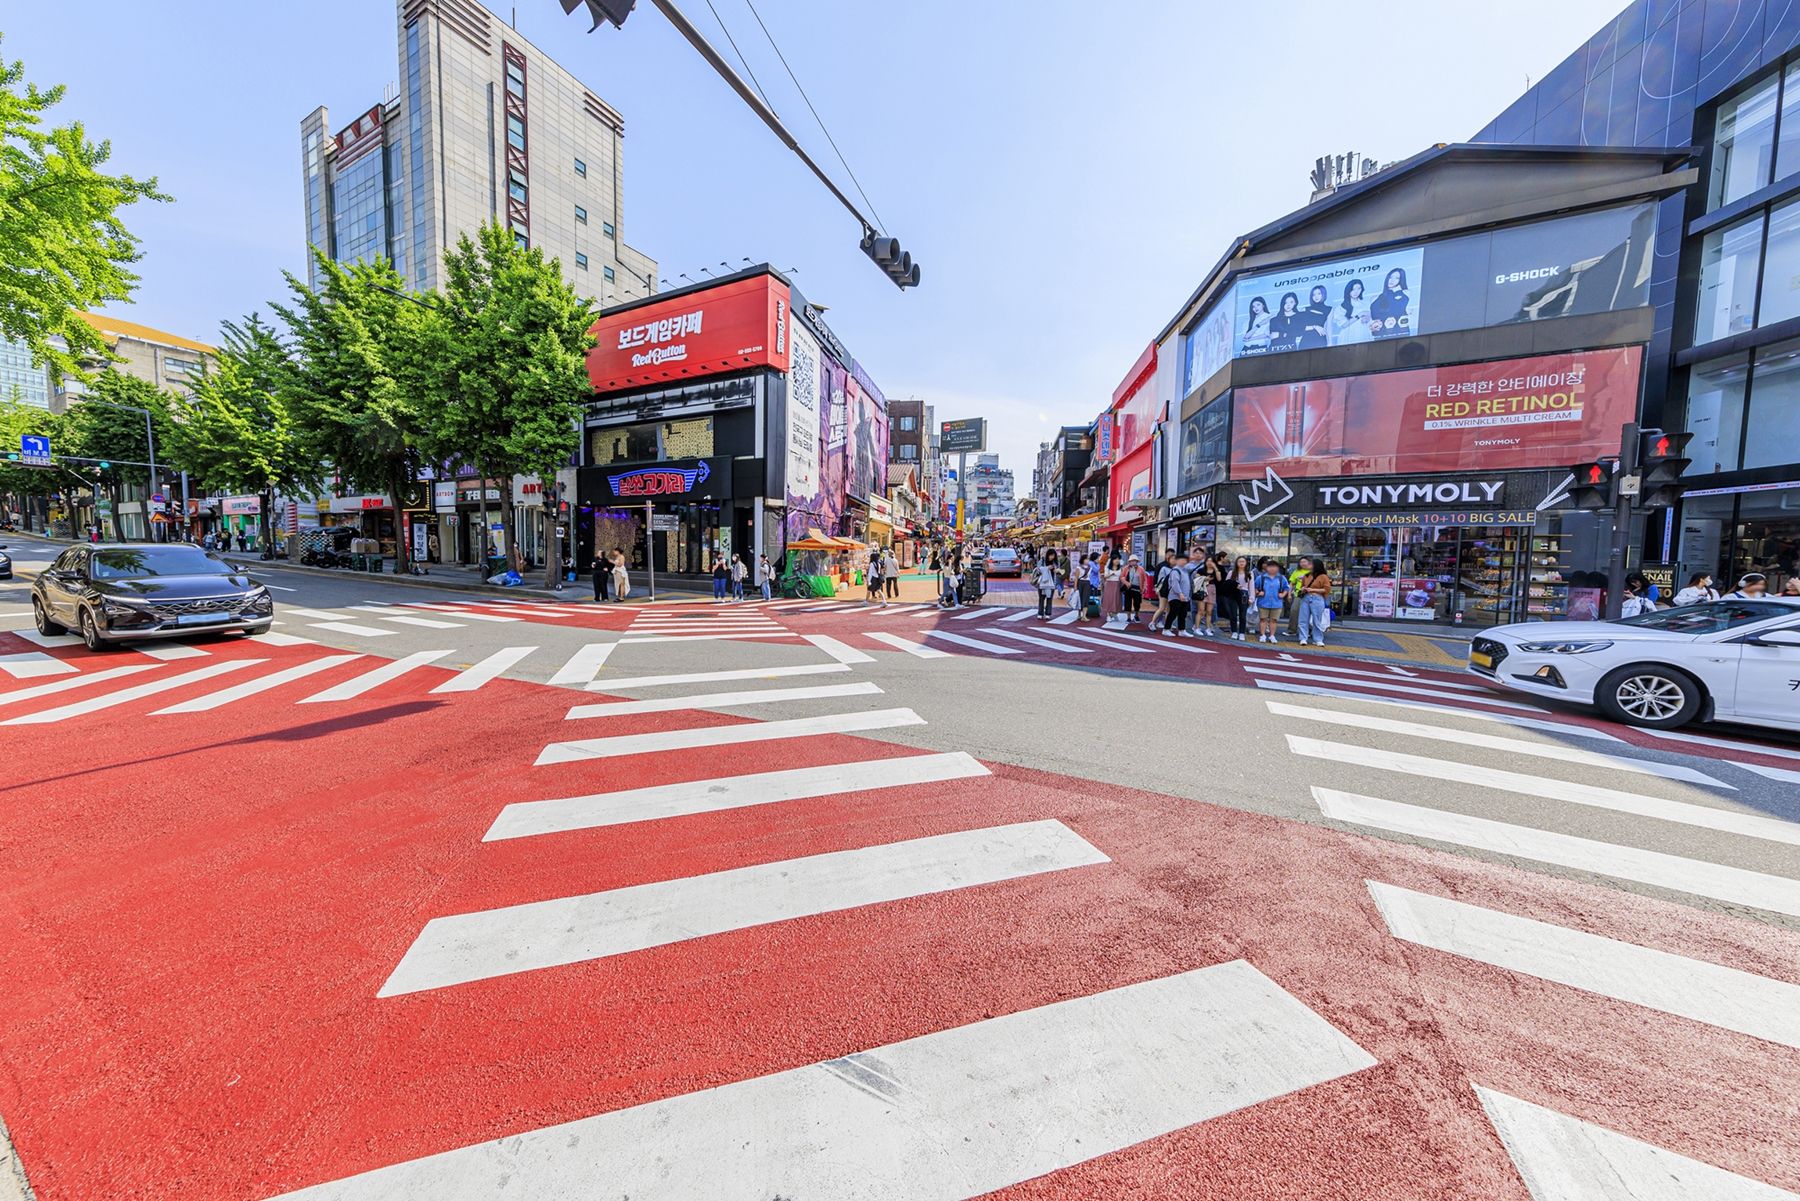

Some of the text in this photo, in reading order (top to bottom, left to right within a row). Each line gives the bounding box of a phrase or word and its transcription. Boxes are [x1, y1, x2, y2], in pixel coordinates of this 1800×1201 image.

[1274, 268, 1355, 288] unstoppable
[1358, 263, 1381, 274] me
[1495, 265, 1560, 285] G-SHOCK
[617, 310, 703, 350] 보드게임카페
[1427, 386, 1441, 398] 더
[1447, 380, 1493, 397] 강력한
[1426, 393, 1585, 418] RED RETINOL
[1432, 412, 1572, 429] 0.1% WRINKLE MULTI CREAM
[1474, 438, 1521, 447] TONYMOLY
[1319, 481, 1505, 505] TONYMOLY
[1169, 493, 1211, 518] TONYMOLY
[1290, 512, 1535, 526] Snail Hydro-gel Mask 10+10 BIG SALE
